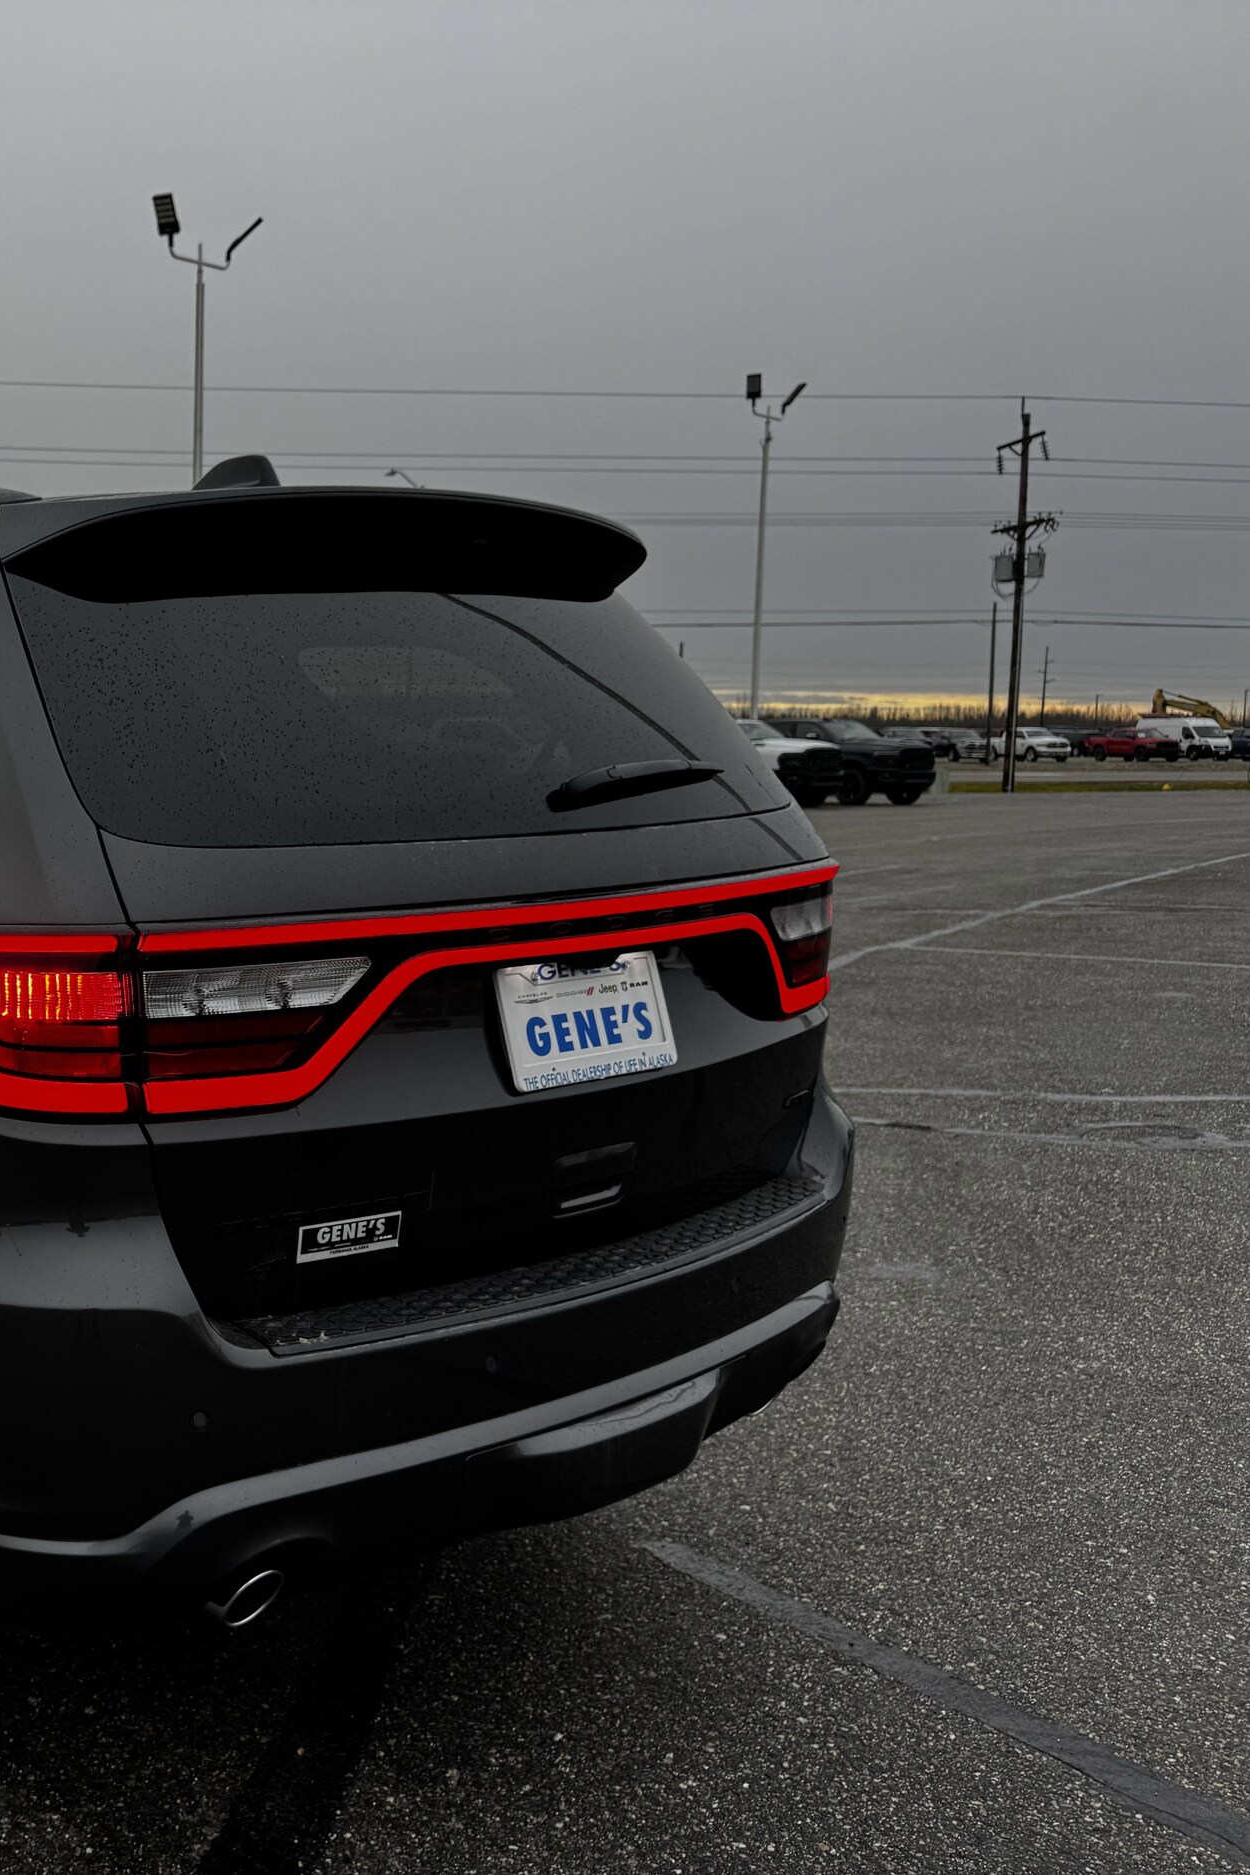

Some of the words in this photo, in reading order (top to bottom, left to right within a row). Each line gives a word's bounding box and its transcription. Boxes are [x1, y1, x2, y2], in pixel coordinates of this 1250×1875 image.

[598, 983, 618, 995] Jeep
[629, 980, 649, 988] RAM
[526, 1001, 653, 1057] GENE'S
[523, 1076, 539, 1090] THE
[540, 1071, 571, 1088] OFFICIAL
[571, 1064, 612, 1081] DEALERSHIP
[613, 1061, 624, 1074] OF
[624, 1058, 638, 1072] LIFE
[638, 1056, 648, 1069] IN
[647, 1053, 674, 1068] ALASKA
[316, 1217, 386, 1244] GENE'S
